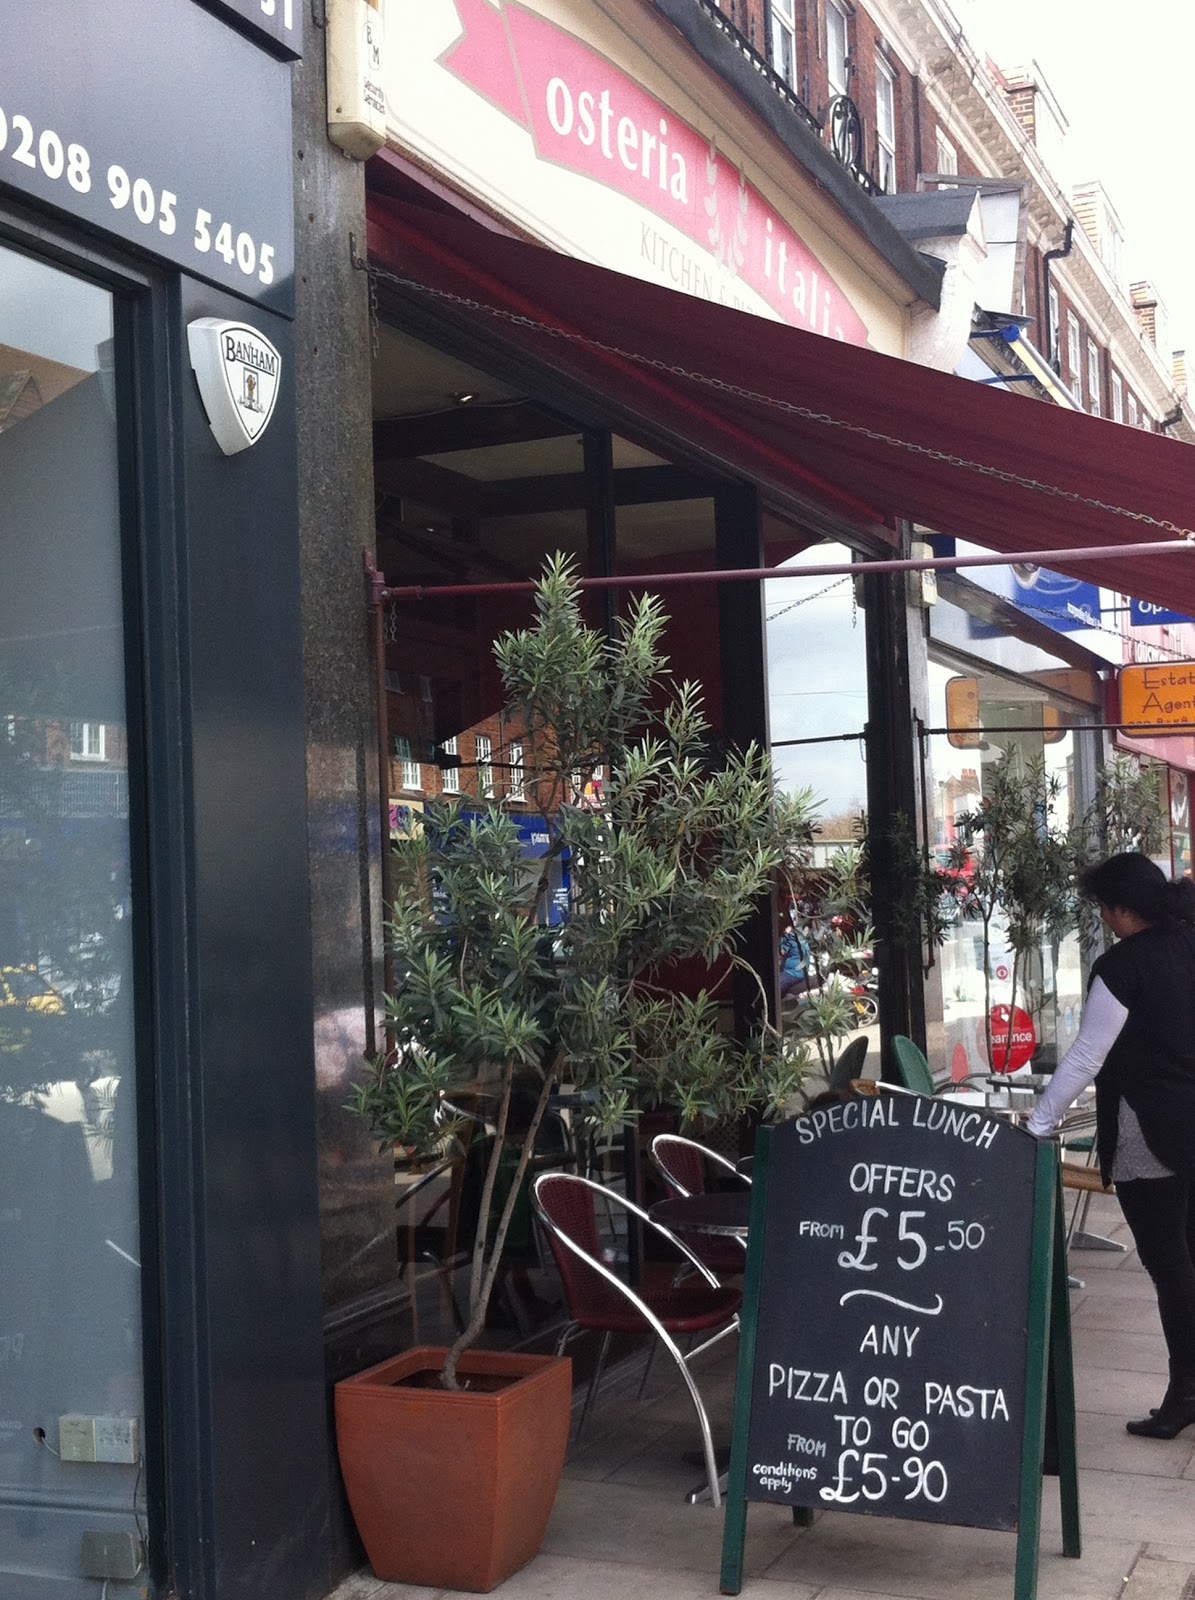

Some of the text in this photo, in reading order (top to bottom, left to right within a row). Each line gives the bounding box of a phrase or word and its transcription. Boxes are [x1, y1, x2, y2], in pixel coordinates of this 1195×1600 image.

[545, 76, 689, 205] osteria
[107, 164, 177, 236] 905
[194, 207, 275, 286] 5405
[640, 221, 713, 302] KITCHEN
[225, 335, 275, 374] BANHAM
[1138, 600, 1170, 615] Op
[795, 1097, 1000, 1149] SPECIAL LUNCH
[849, 1162, 956, 1202] OFFERS
[859, 1325, 920, 1358] ANY
[769, 1363, 1009, 1421] PIZZA OR PASTA
[787, 1433, 826, 1458] FROM
[834, 1415, 930, 1451] TO GO
[752, 1461, 818, 1482] conditions
[759, 1476, 792, 1494] apply
